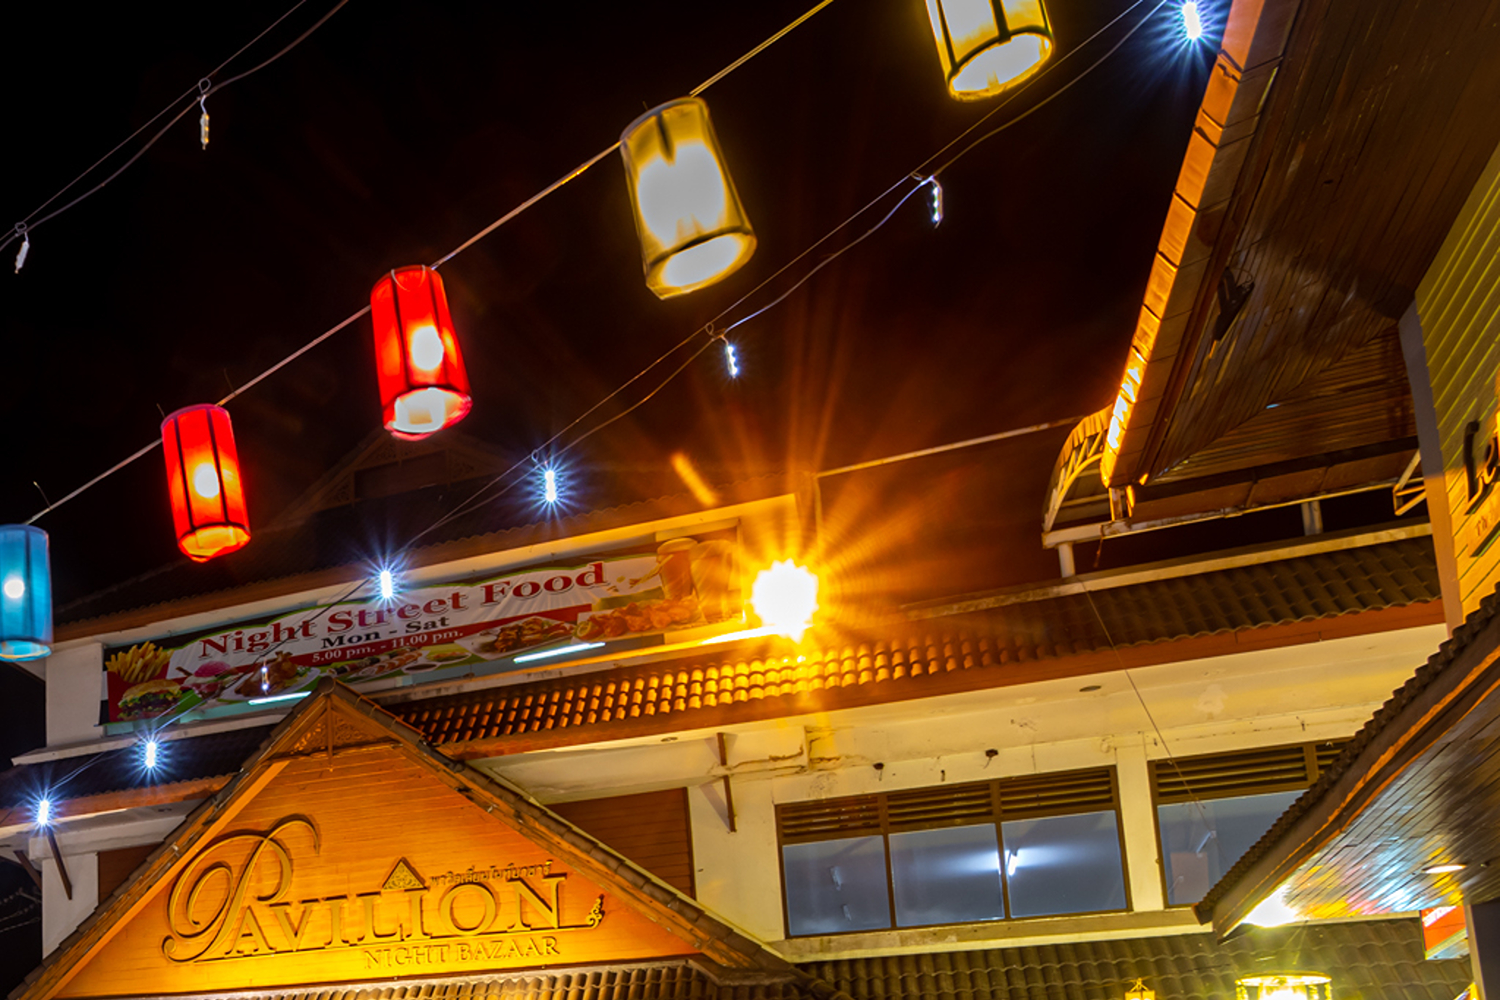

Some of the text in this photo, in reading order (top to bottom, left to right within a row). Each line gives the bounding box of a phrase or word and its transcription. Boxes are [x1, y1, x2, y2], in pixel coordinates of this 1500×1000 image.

[199, 562, 609, 659] Night Street Food
[312, 648, 342, 663] 5.00
[346, 645, 376, 659] pm.
[392, 635, 428, 649] 11.00
[432, 630, 464, 644] pm.
[321, 630, 381, 649] Mon
[405, 616, 450, 634] Sat
[162, 813, 568, 964] PAVILION
[363, 935, 562, 970] NIGHT BAZAAR
